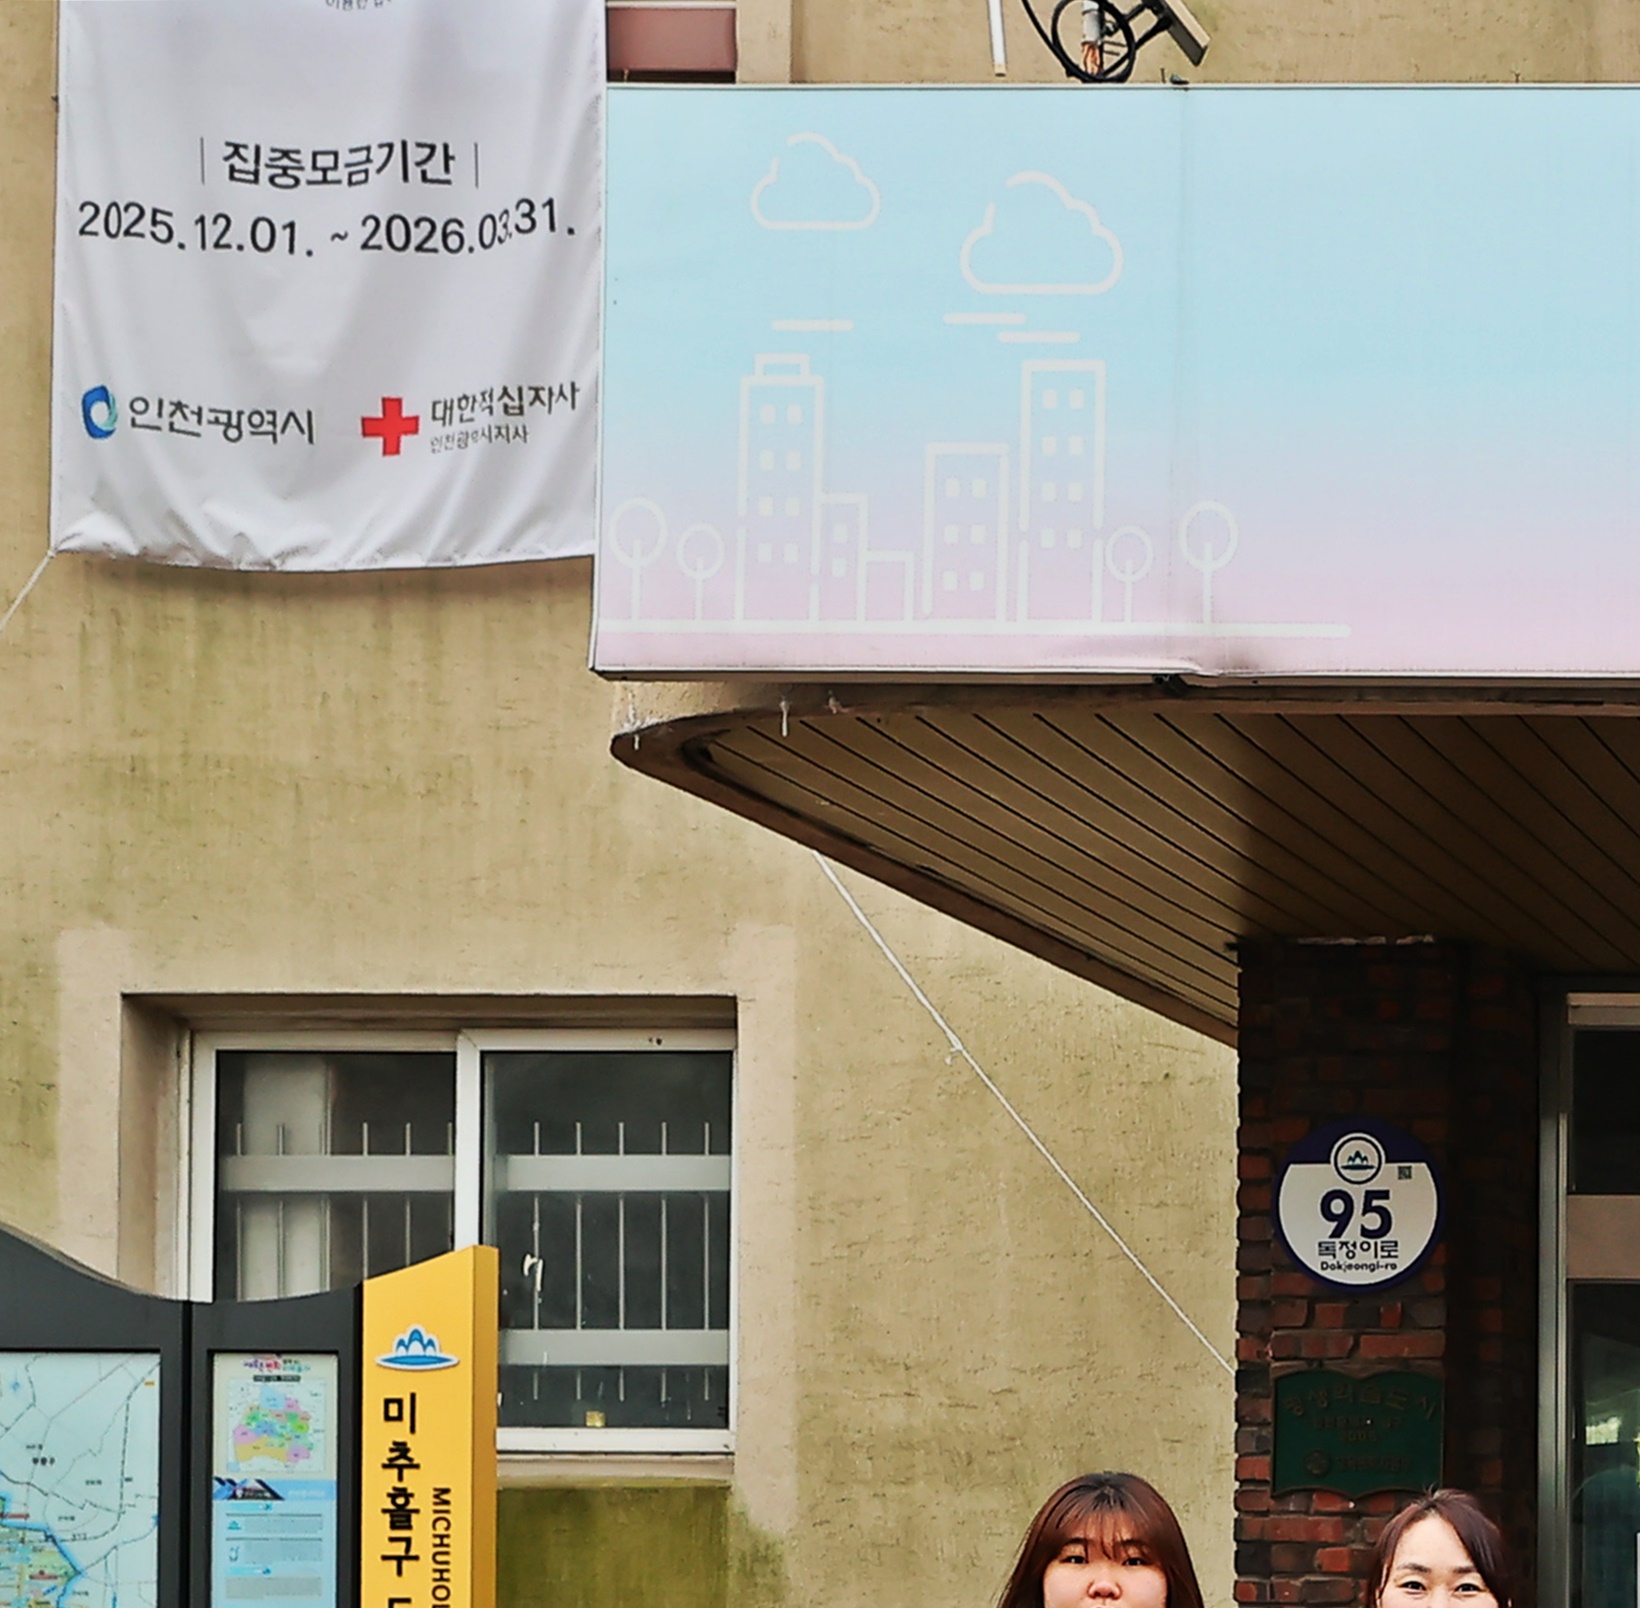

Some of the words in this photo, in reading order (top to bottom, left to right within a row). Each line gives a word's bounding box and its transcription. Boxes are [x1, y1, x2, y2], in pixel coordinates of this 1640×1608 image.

[222, 139, 455, 189] 집중모금기간
[78, 201, 314, 257] 2025.12.01.
[360, 197, 576, 255] 2026.03.31.
[128, 395, 316, 444] 인천광역시
[430, 381, 580, 427] 대한적십자사
[1320, 1189, 1392, 1239] 95
[1318, 1240, 1398, 1259] 독정이로
[381, 1392, 420, 1577] 미추홀구
